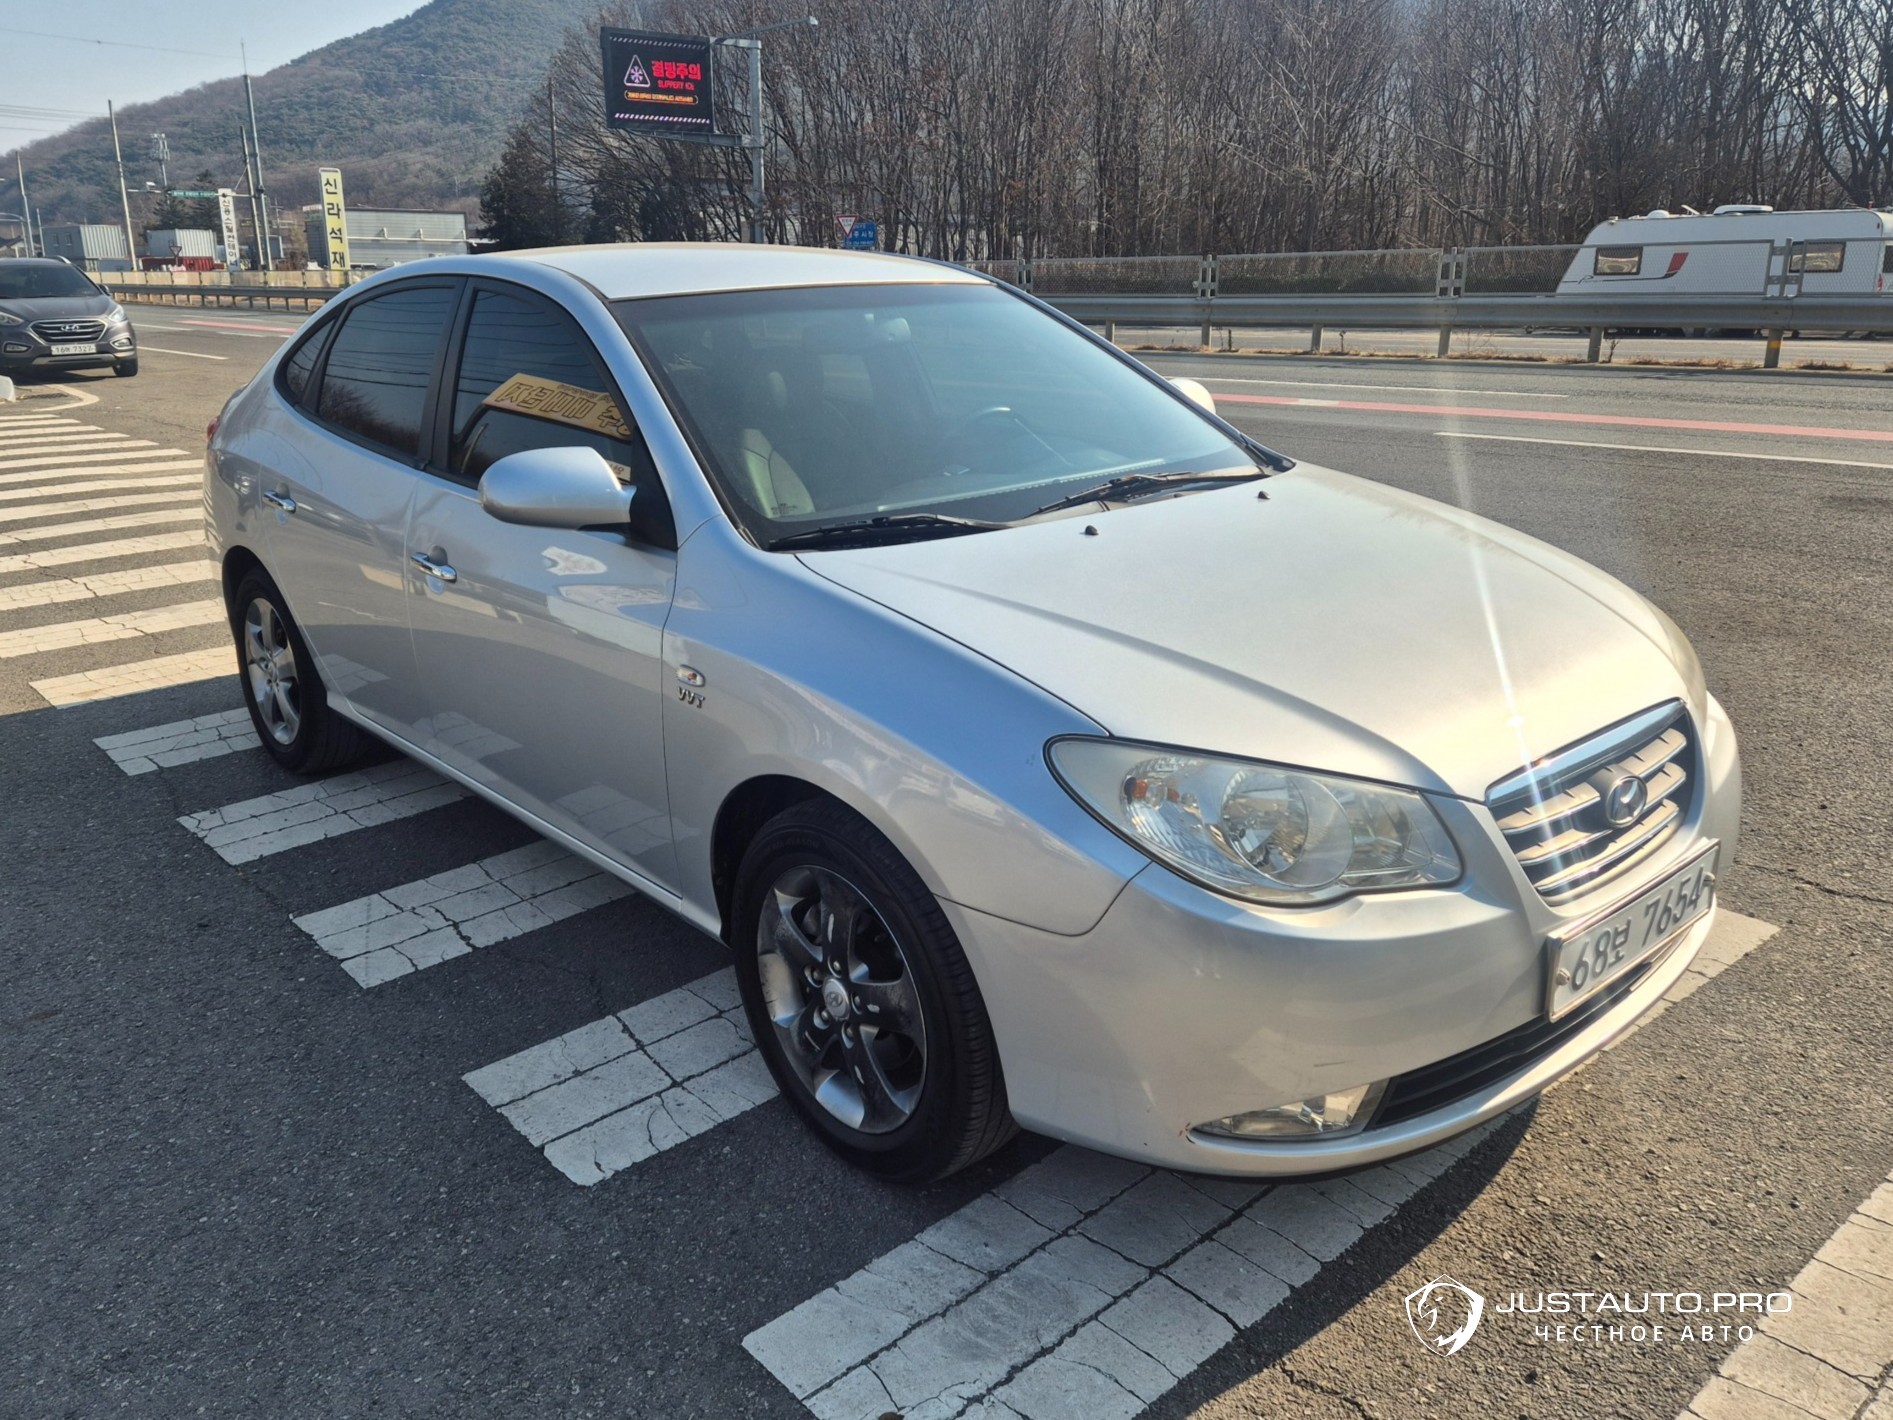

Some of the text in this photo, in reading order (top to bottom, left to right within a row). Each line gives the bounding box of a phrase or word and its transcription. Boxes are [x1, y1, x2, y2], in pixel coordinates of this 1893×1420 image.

[324, 178, 346, 268] 신라석재
[678, 686, 706, 709] VVT
[1570, 864, 1705, 991] 68보 7654
